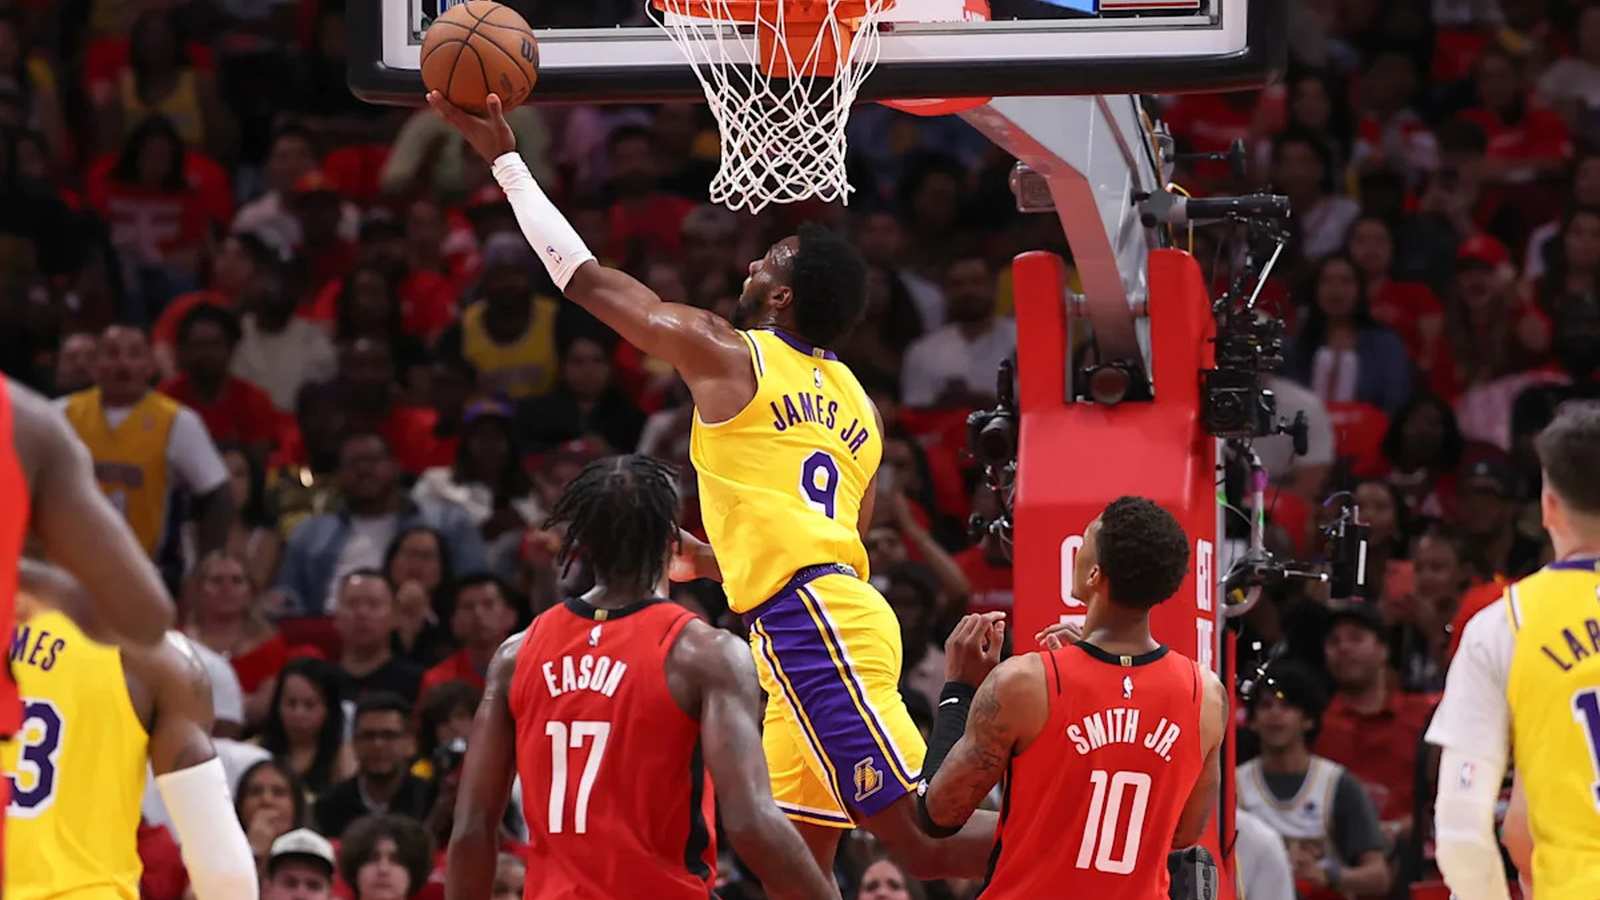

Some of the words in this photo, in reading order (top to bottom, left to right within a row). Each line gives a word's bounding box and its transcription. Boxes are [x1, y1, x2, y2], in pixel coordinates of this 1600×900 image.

[770, 392, 838, 431] JAMES
[840, 418, 869, 460] JR.
[801, 450, 839, 520] 9
[542, 655, 627, 698] EASON
[9, 700, 64, 812] 3
[1066, 708, 1140, 755] SMITH
[1144, 718, 1182, 762] JR.
[545, 720, 612, 834] 17
[1075, 769, 1152, 875] 10
